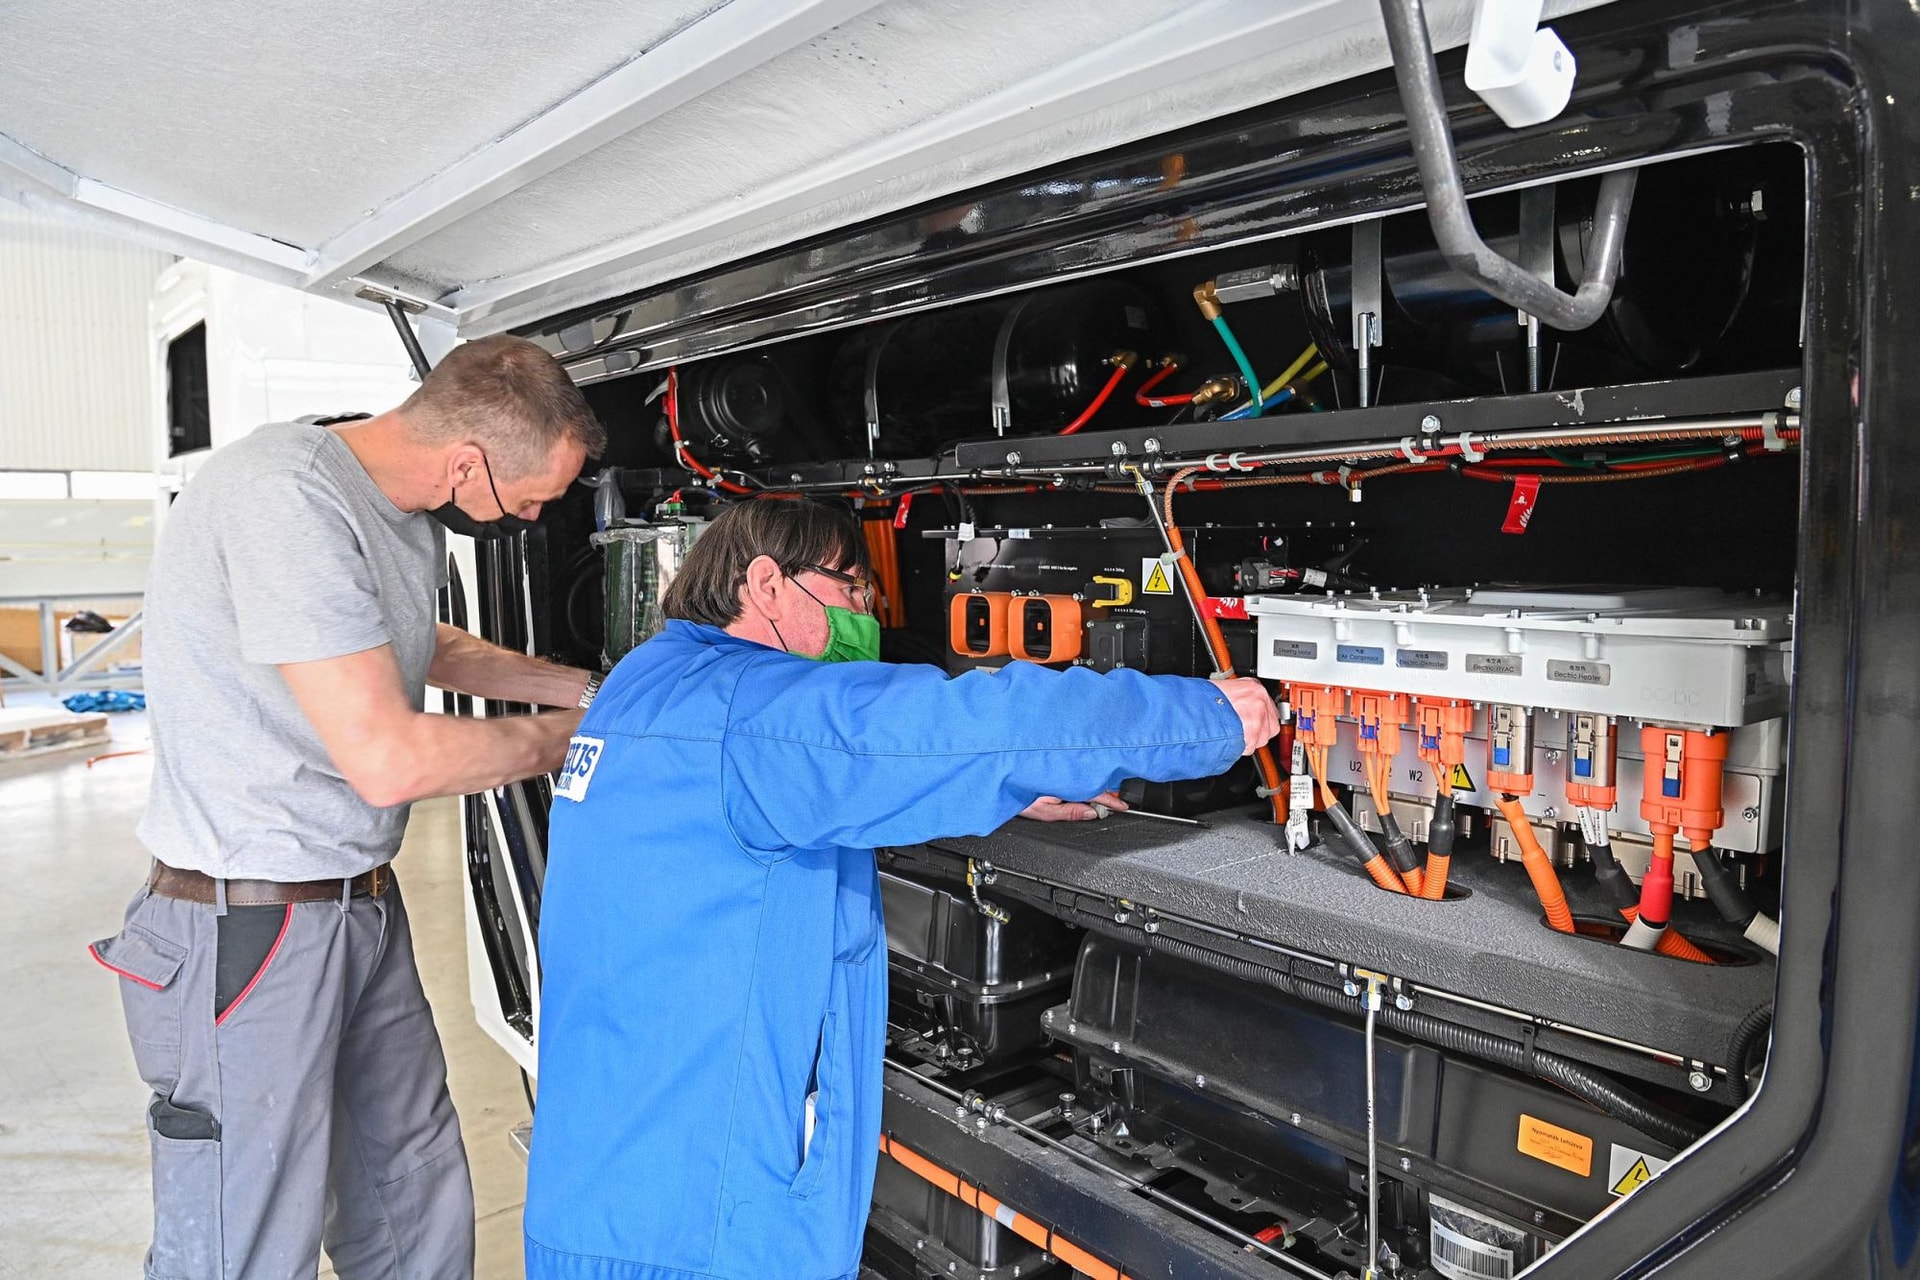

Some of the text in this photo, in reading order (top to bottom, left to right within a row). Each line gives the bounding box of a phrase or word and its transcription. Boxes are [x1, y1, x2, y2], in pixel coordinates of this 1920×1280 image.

[1496, 665, 1514, 673] HVAC
[1554, 671, 1602, 681] Electric Heater
[1349, 760, 1363, 773] U2
[1409, 769, 1423, 782] W2
